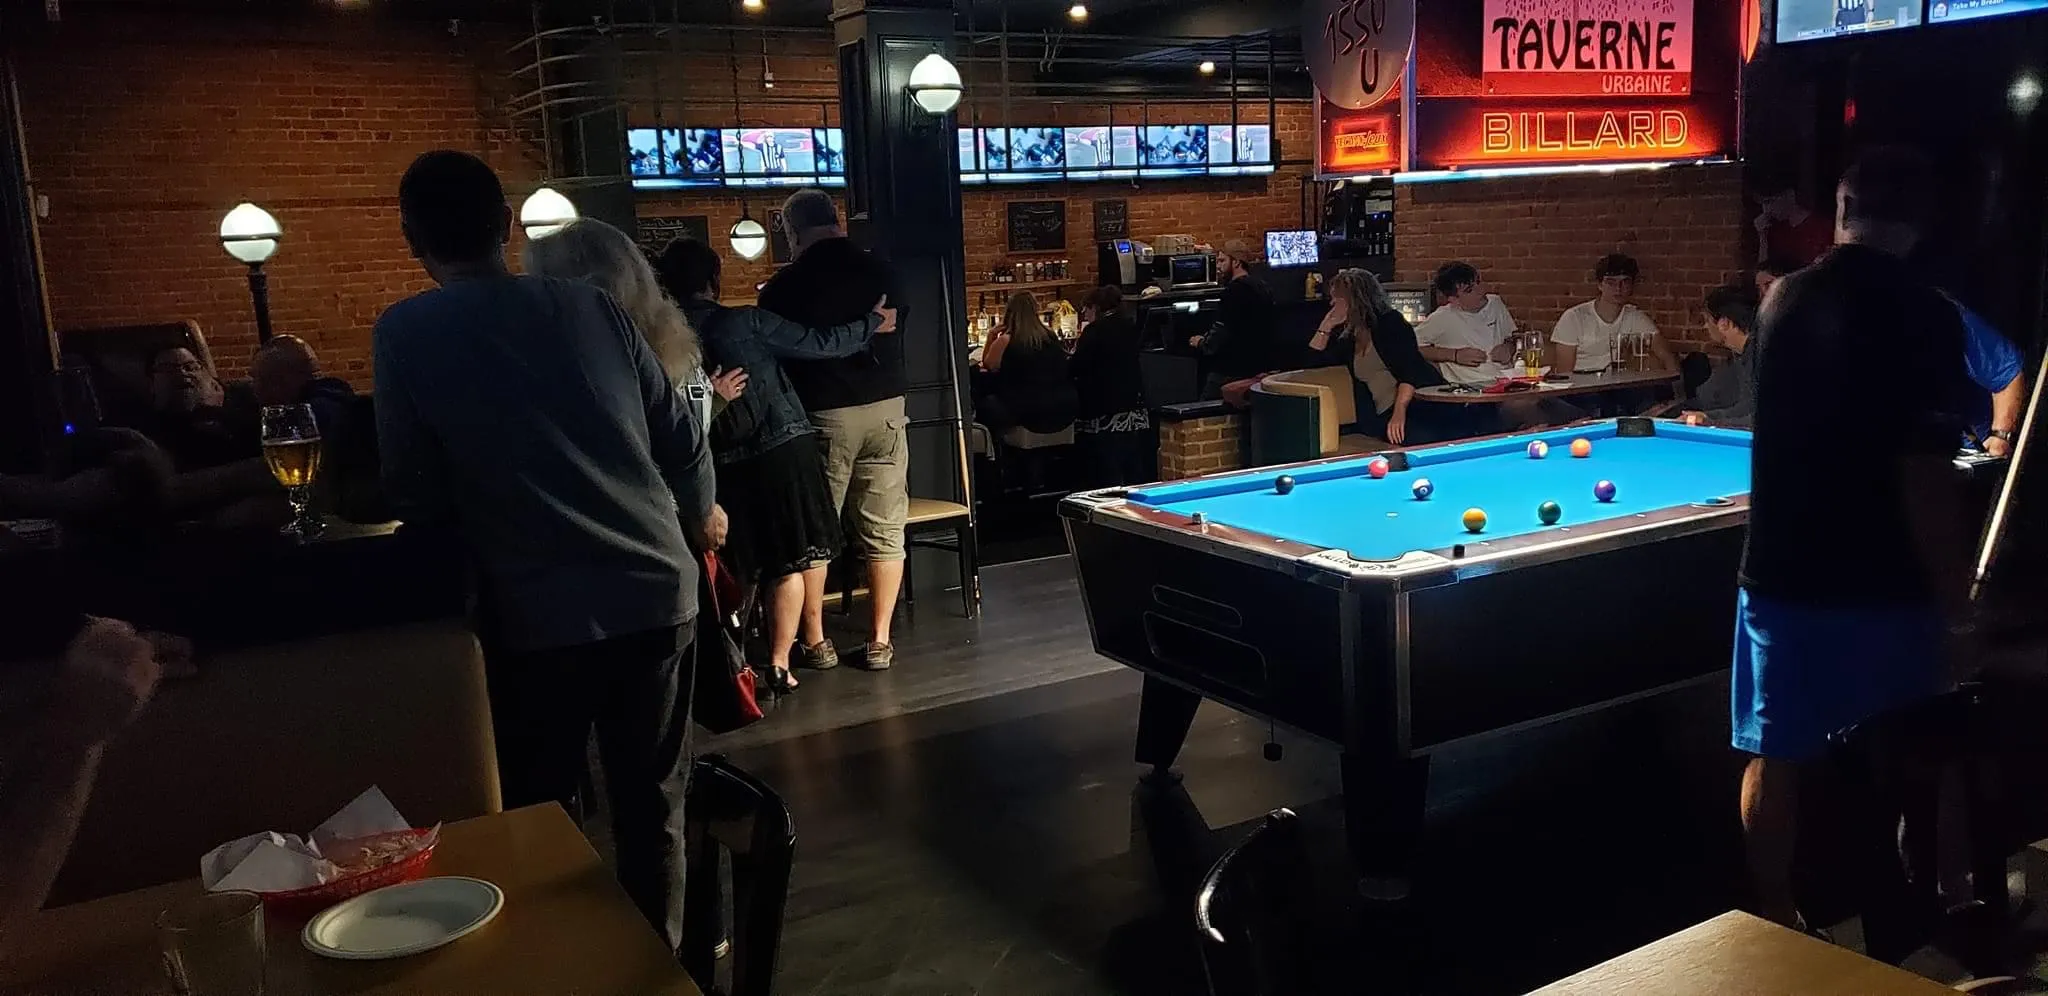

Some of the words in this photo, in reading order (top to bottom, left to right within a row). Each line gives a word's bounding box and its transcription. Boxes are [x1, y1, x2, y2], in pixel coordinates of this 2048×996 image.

[1492, 17, 1677, 70] TAVERNE
[1602, 75, 1672, 93] URBAINE
[1483, 110, 1688, 153] BILLARD
